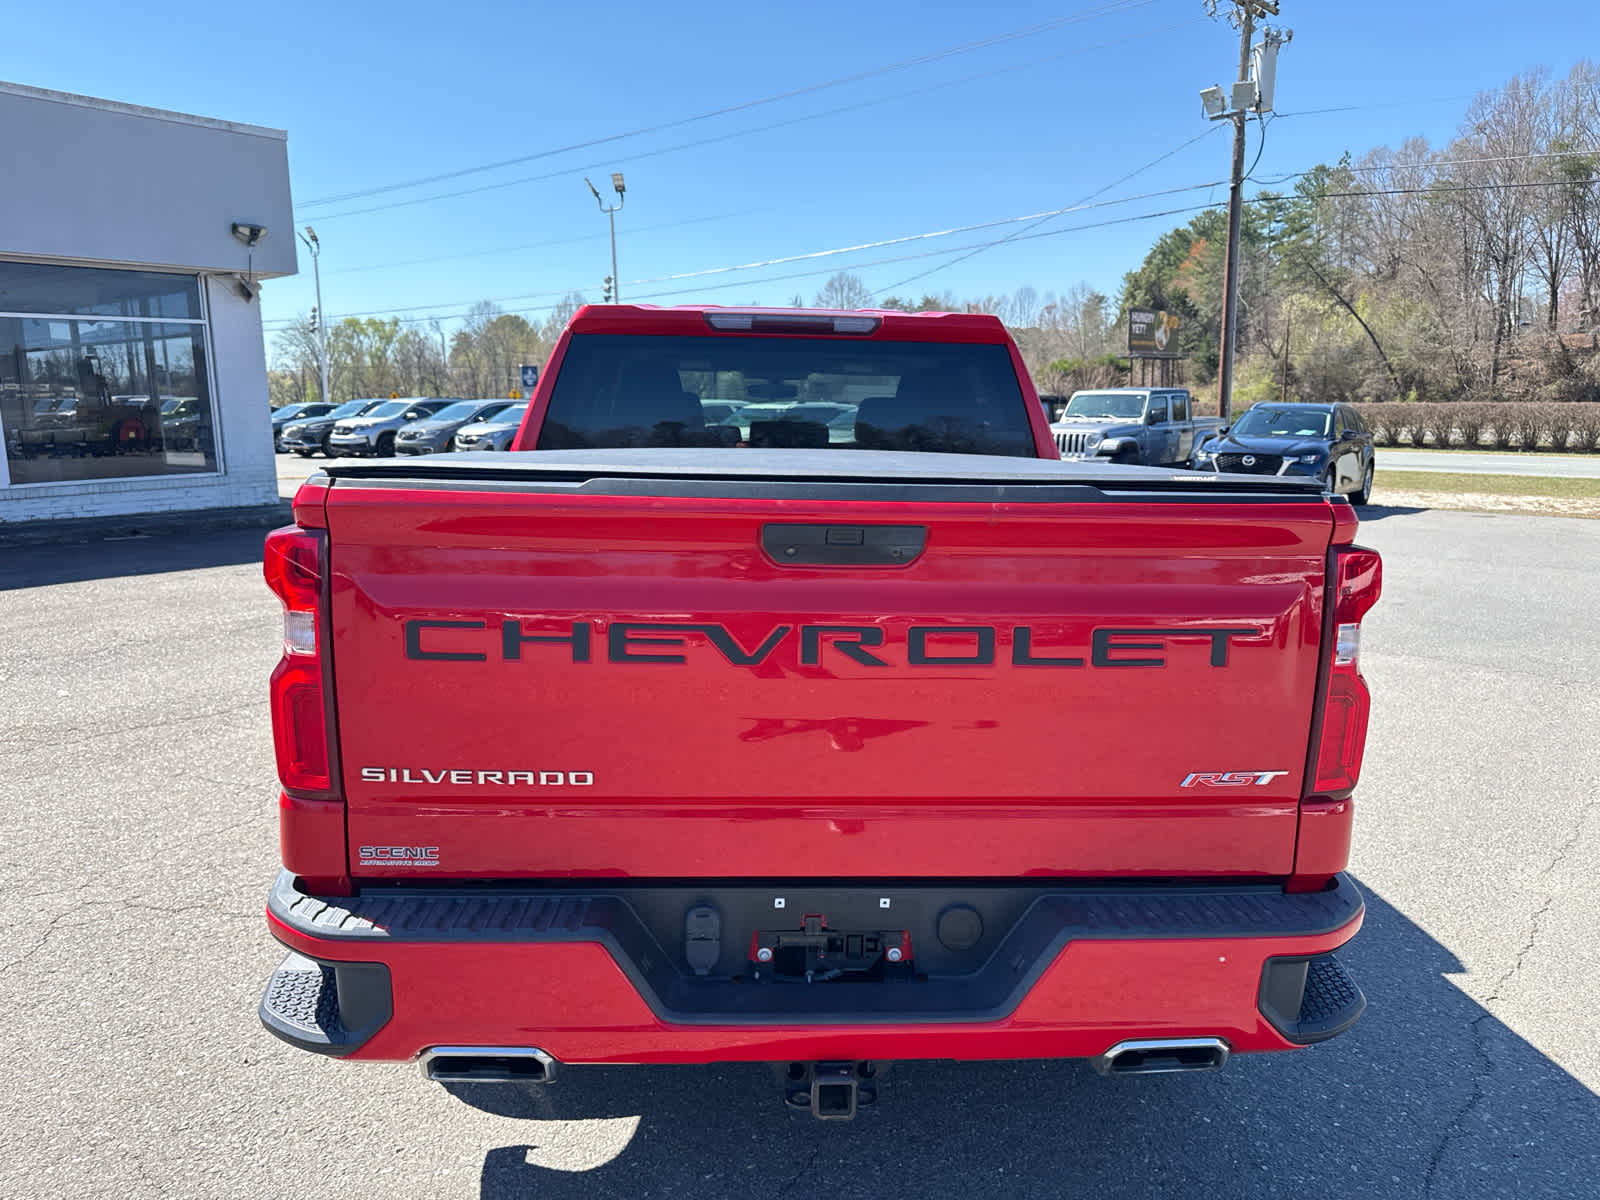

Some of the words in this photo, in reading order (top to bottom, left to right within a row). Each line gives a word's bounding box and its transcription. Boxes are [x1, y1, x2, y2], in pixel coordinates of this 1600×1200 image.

[405, 619, 1259, 668] CHEVROLET
[361, 767, 594, 786] SILVERADO
[1180, 770, 1289, 787] RST
[359, 846, 439, 859] SCENIC
